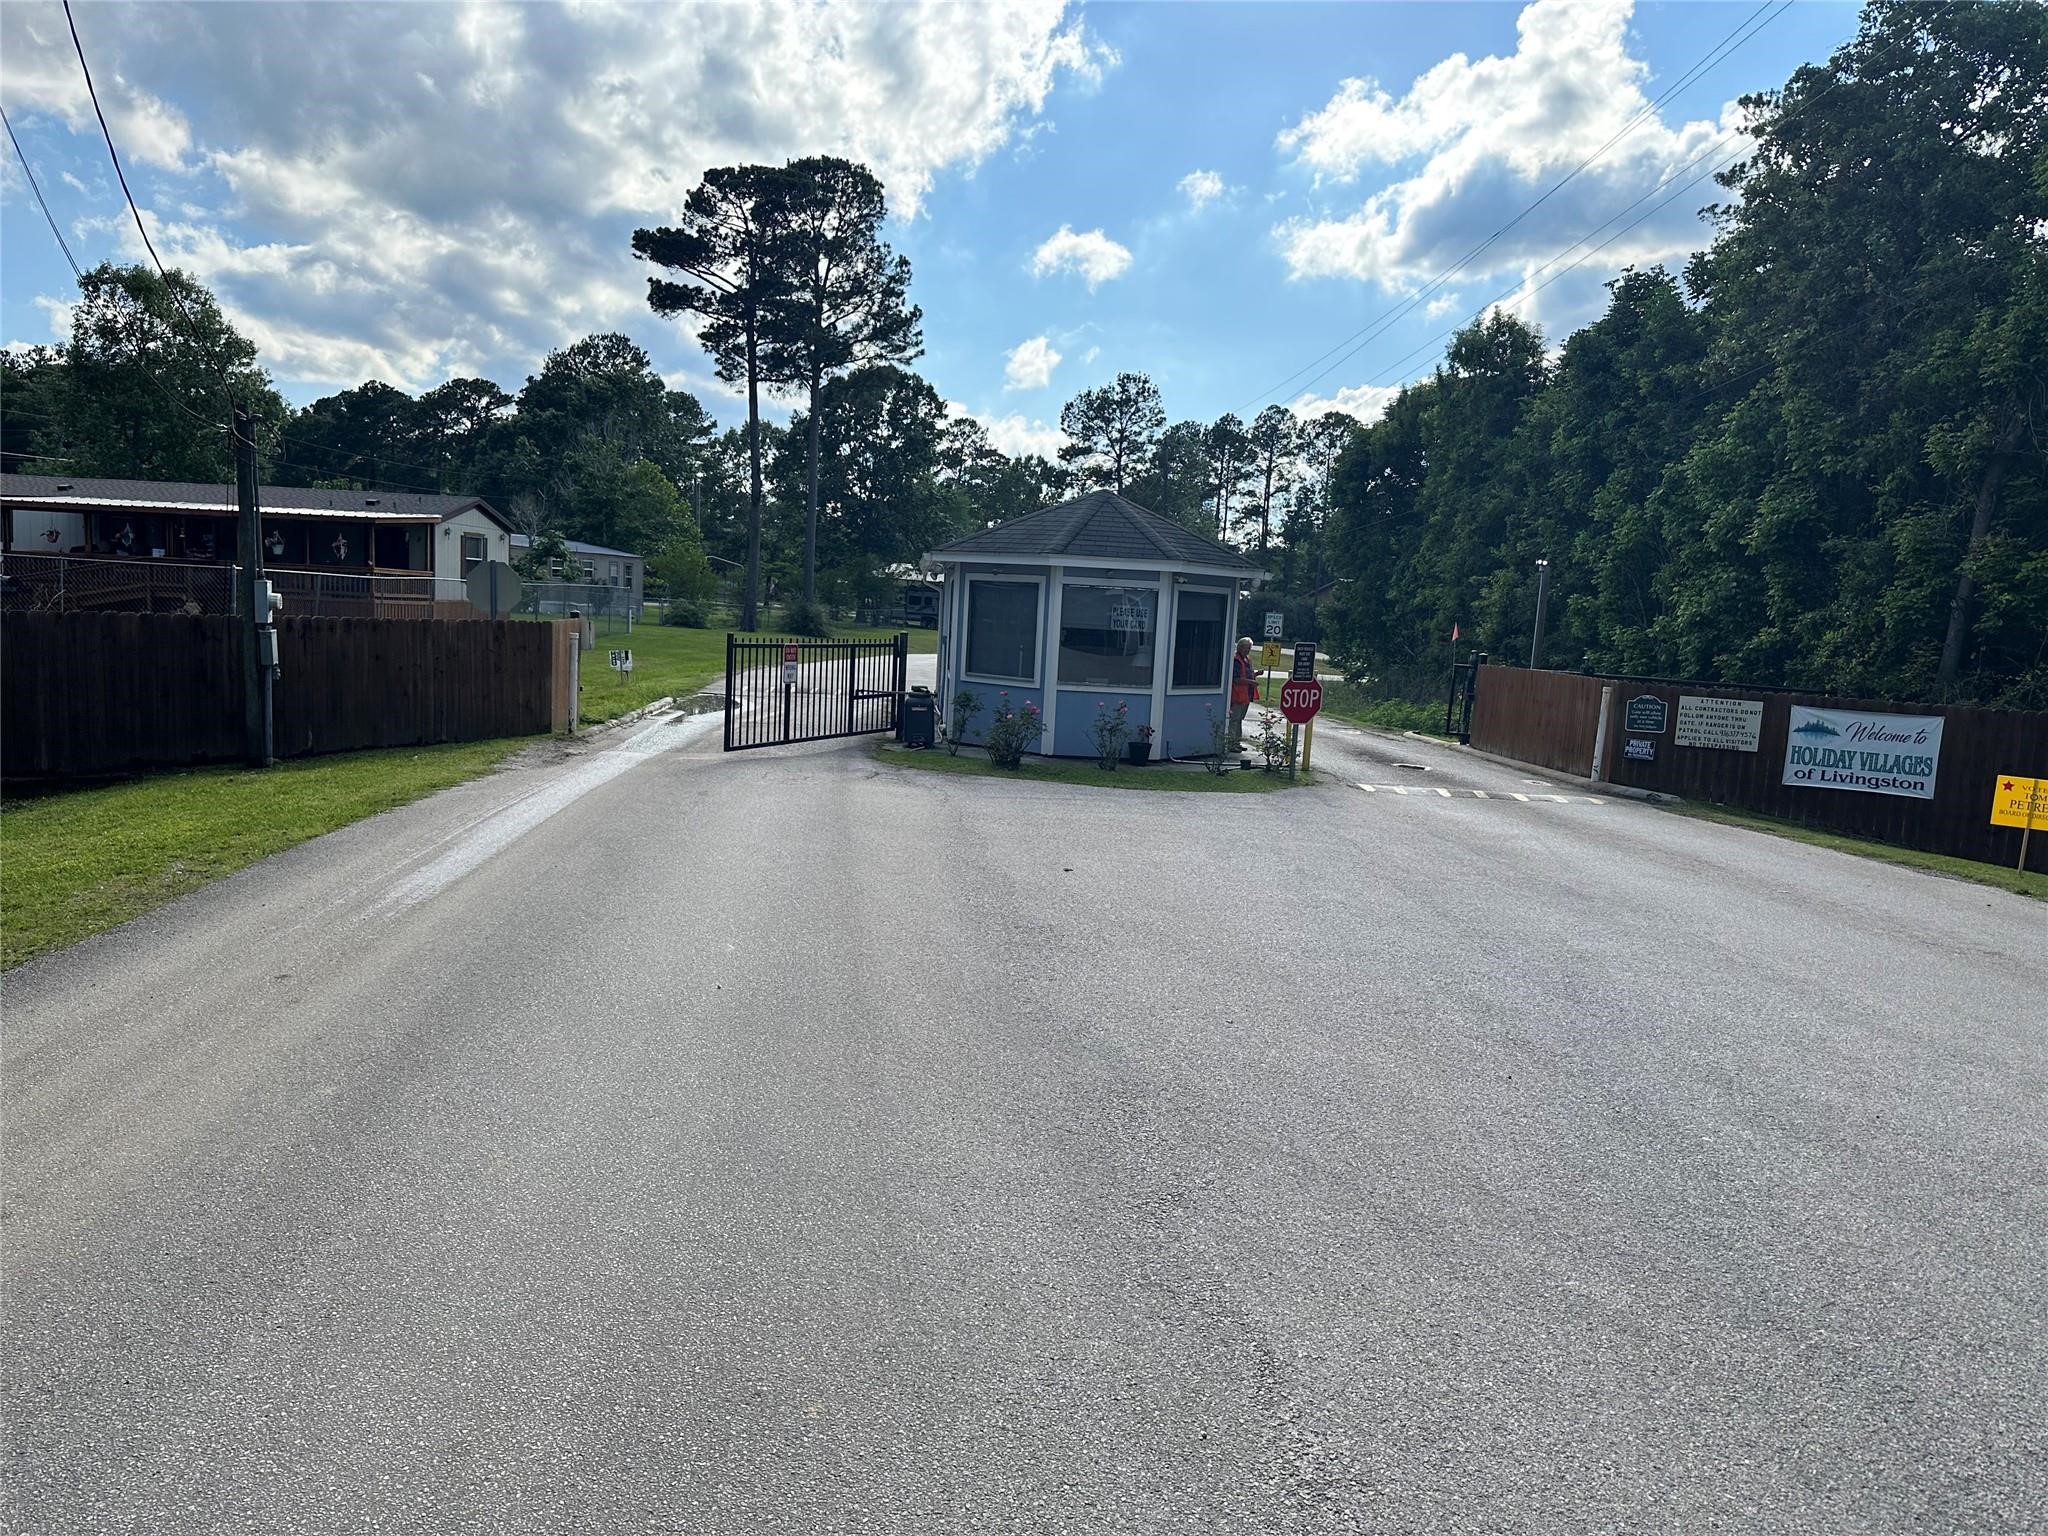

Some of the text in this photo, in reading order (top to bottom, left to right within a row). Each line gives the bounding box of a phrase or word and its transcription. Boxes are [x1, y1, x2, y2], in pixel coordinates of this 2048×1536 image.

[1112, 607, 1148, 618] PLEASE USE
[1113, 619, 1146, 630] YOUR CARD
[1266, 625, 1281, 635] 20
[1283, 689, 1320, 709] STOP
[1694, 706, 1739, 714] CONTRACTORS
[1845, 721, 1929, 745] Welcome to
[1629, 740, 1651, 748] PRIVATE
[1625, 747, 1653, 755] PROPERTY
[1790, 745, 1934, 778] HOLIDAY VILLAGES
[1793, 769, 1925, 791] of Livingston
[2022, 785, 2048, 793] VOTE
[2024, 793, 2048, 802] TOM
[1999, 809, 2021, 817] BOARD
